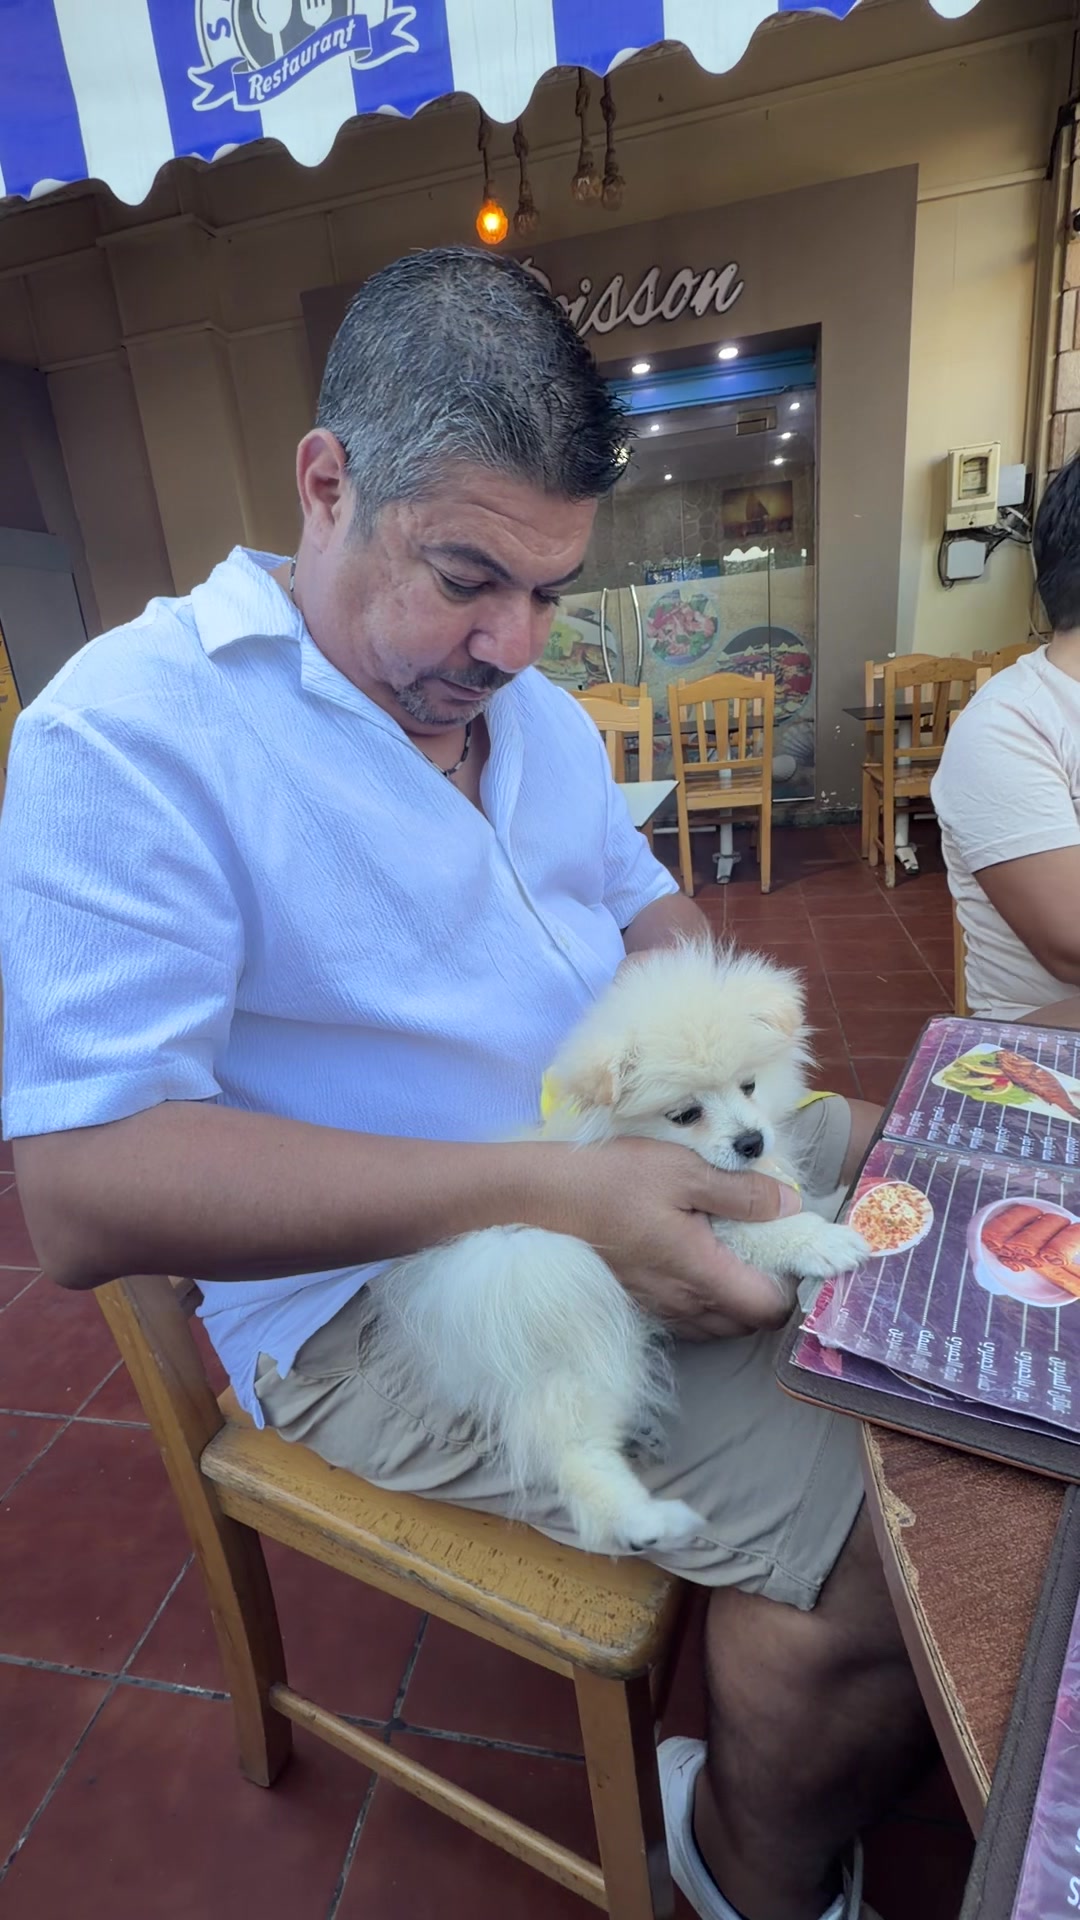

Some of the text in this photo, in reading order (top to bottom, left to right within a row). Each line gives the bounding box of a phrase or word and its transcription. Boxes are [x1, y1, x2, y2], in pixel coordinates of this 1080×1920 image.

[248, 19, 356, 101] Restaurant
[519, 257, 745, 337] isson
[976, 1341, 998, 1376] الجمبري
[1047, 1356, 1072, 1392] السردين
